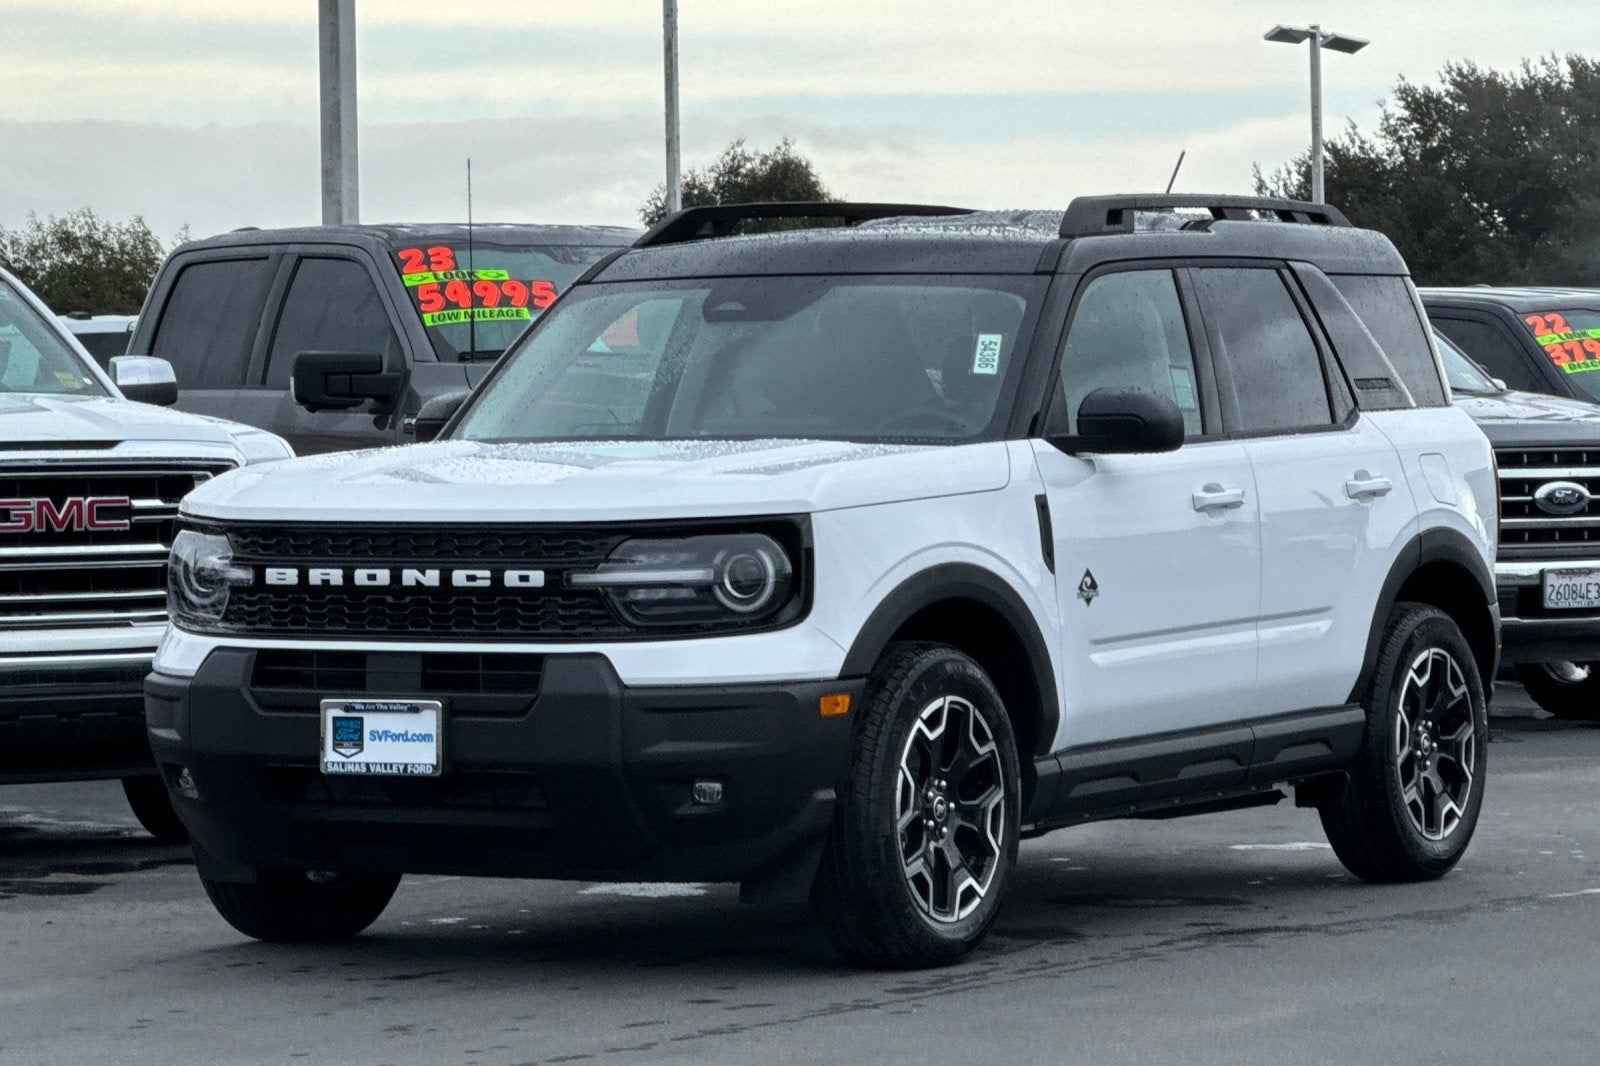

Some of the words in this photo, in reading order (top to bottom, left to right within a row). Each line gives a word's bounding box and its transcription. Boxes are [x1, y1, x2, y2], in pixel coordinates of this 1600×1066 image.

[398, 247, 455, 273] 23
[433, 270, 479, 281] LOOK
[418, 280, 557, 312] 54995
[431, 312, 460, 323] LOW
[464, 309, 524, 320] MILEAGE
[1525, 313, 1571, 336] 22
[1544, 338, 1600, 366] 379
[1568, 361, 1600, 370] DISC
[1553, 490, 1579, 503] Ford
[0, 496, 130, 532] GMC
[265, 568, 545, 587] BRONCO
[1548, 582, 1600, 602] 26084E3
[369, 730, 434, 742] SVFord.com
[327, 763, 366, 772] SALINAS
[369, 764, 405, 773] VALLEY
[408, 764, 433, 774] FORD
